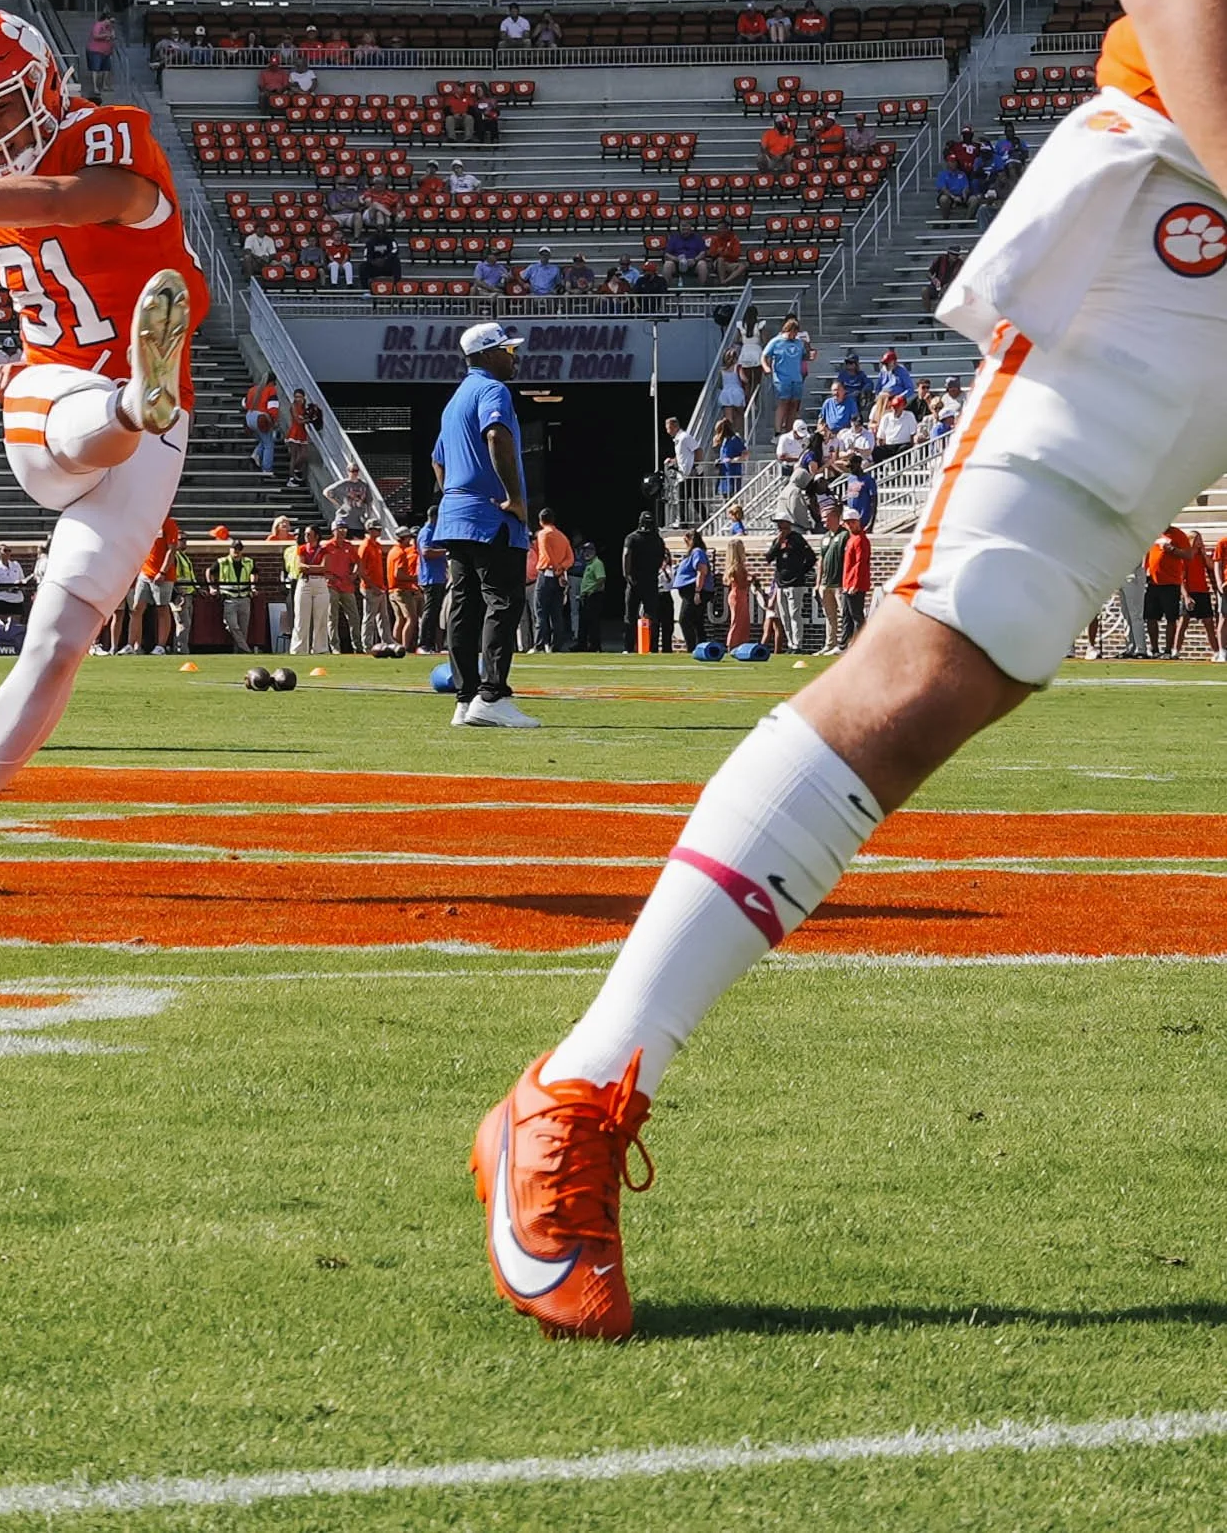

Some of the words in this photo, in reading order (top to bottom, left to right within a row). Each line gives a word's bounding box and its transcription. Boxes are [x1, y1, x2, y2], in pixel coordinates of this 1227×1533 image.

[84, 122, 134, 166] 81
[383, 325, 417, 351] DR.
[528, 325, 629, 351] BOWMAN
[569, 353, 635, 380] ROOM
